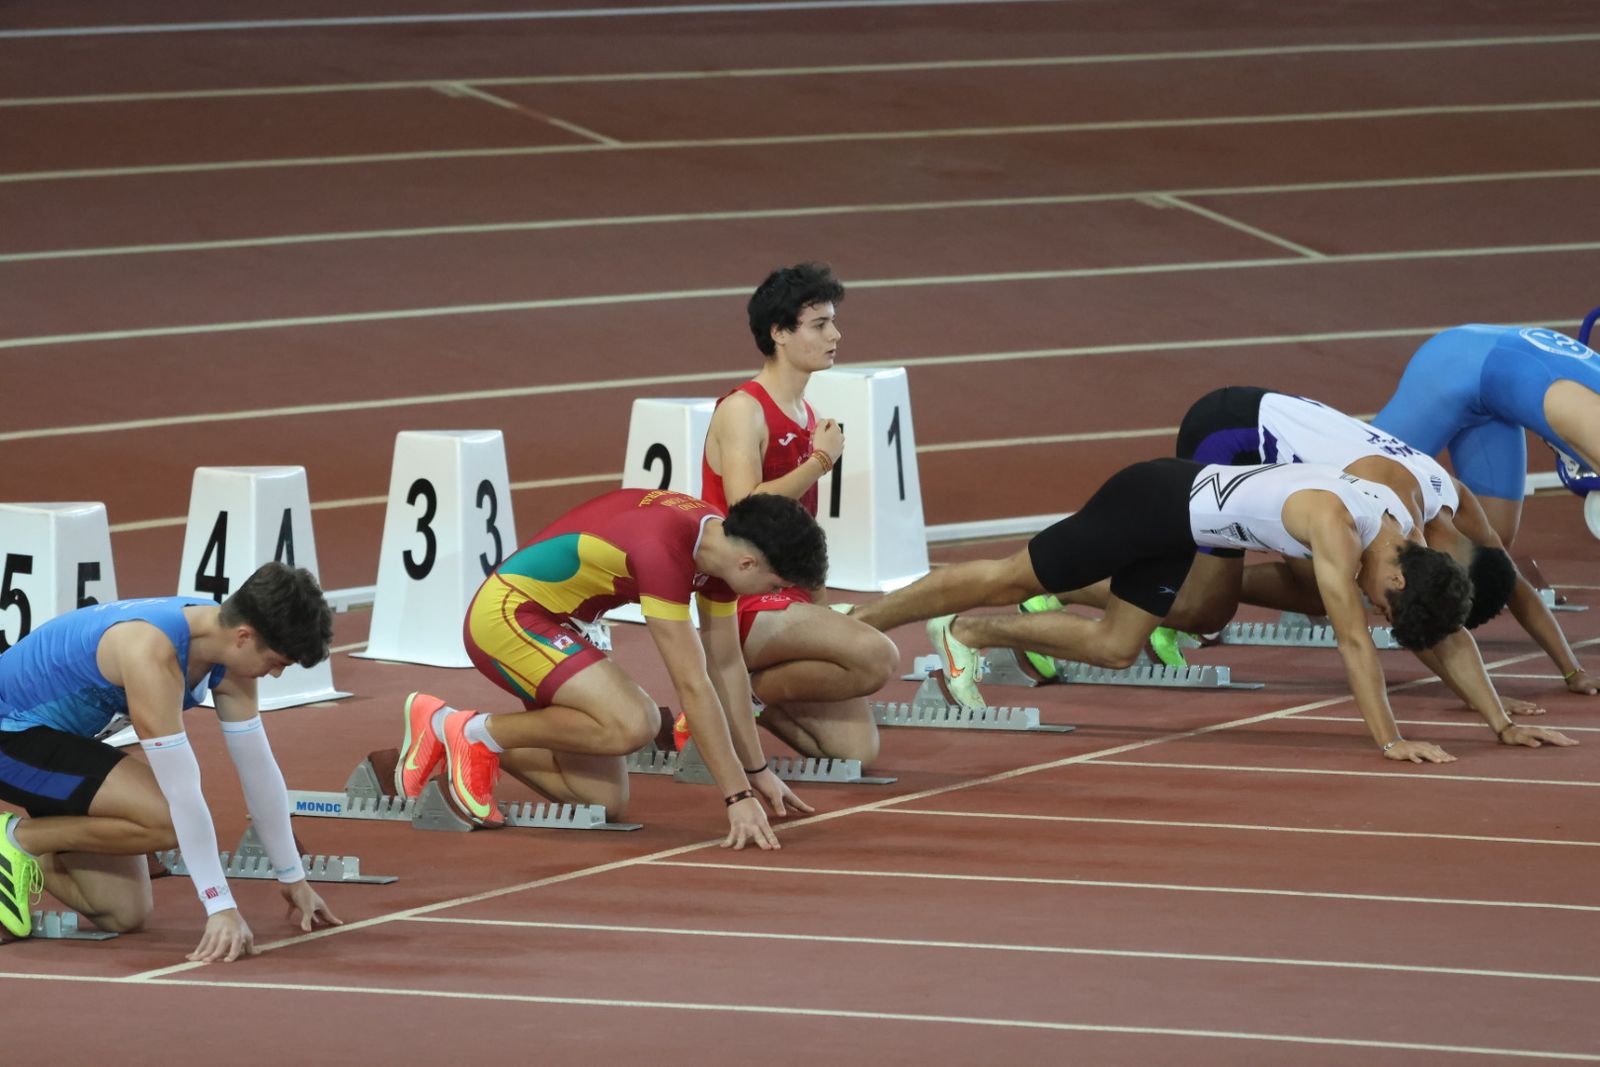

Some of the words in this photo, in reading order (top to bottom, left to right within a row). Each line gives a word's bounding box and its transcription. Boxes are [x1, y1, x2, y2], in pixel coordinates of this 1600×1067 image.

[888, 406, 905, 501] 1
[195, 511, 230, 603] 4
[403, 478, 437, 580] 3
[476, 479, 502, 576] 3
[0, 553, 33, 652] 5
